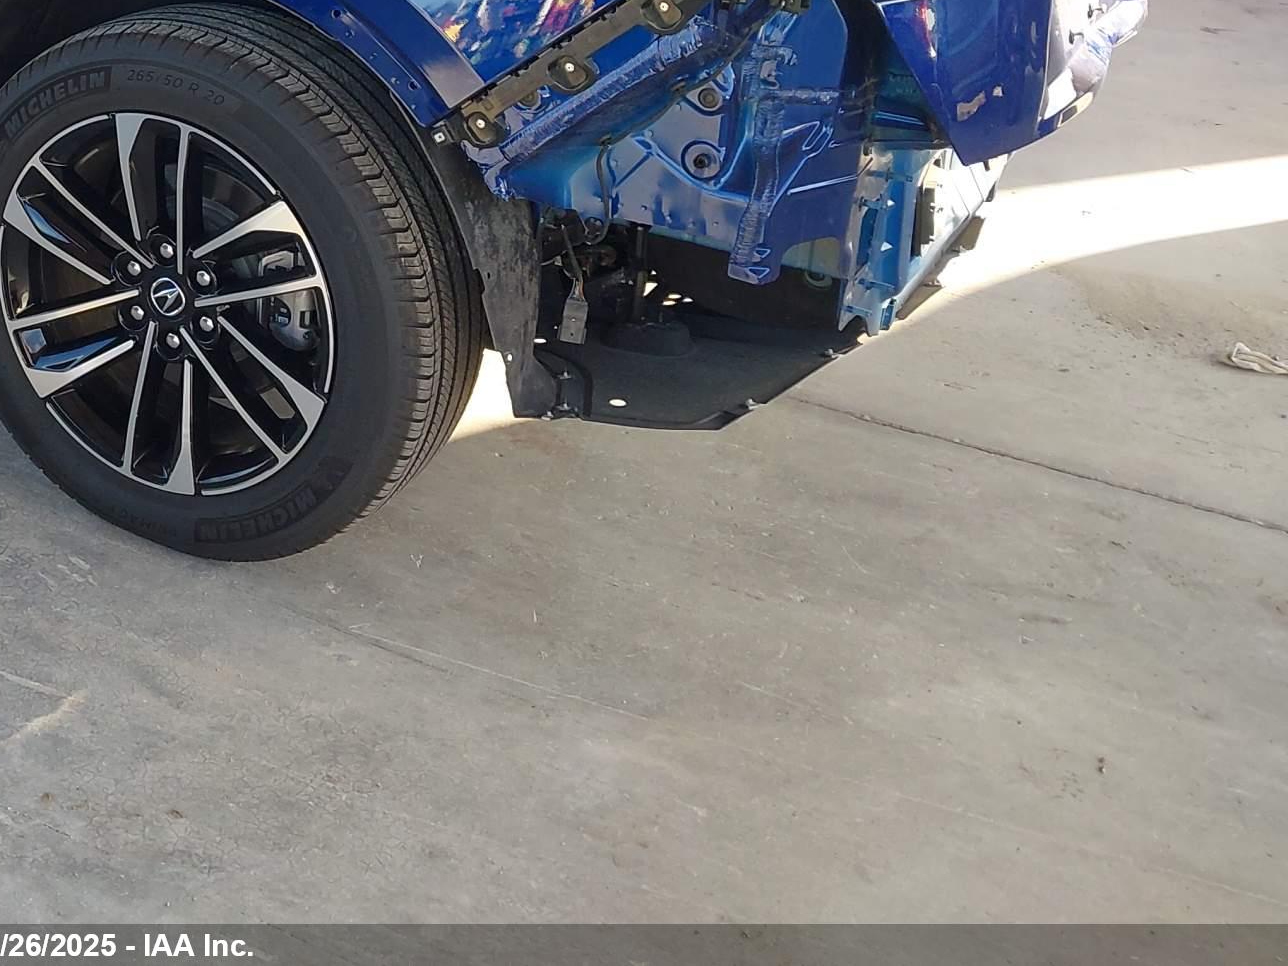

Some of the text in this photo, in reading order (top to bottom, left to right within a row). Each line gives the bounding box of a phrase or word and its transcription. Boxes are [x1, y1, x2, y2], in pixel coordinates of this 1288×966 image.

[4, 70, 105, 132] MICHELIN
[188, 82, 200, 94] R
[207, 89, 225, 107] 20
